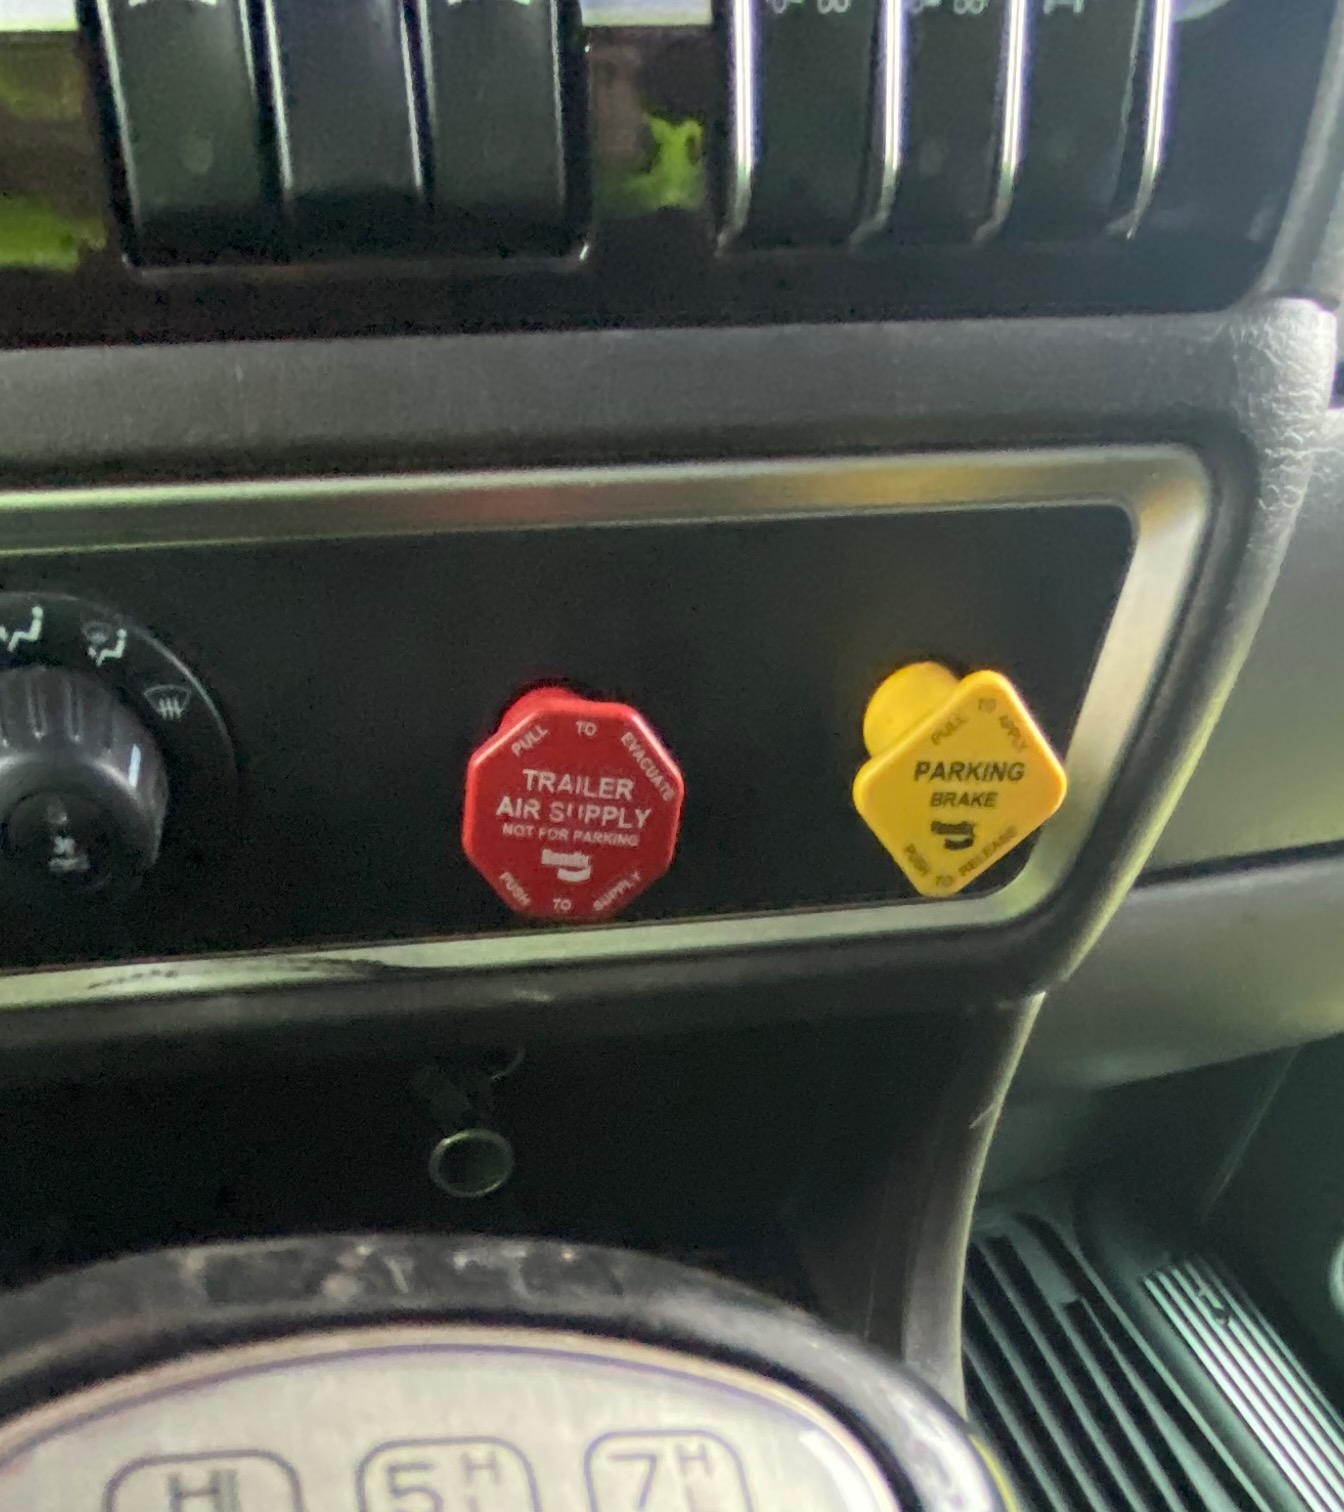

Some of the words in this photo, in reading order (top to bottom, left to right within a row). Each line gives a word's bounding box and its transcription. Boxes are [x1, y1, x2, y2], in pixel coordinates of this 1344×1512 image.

[511, 726, 549, 757] PULL
[576, 721, 597, 737] TO
[620, 731, 676, 802] EVACUATE
[913, 761, 1025, 782] PARKING
[523, 769, 634, 800] TRAILER
[930, 792, 999, 808] BRAKE
[496, 796, 540, 820] AIR
[549, 801, 653, 829] SUPPLY
[503, 823, 533, 838] NOT
[539, 827, 568, 841] FOR
[573, 830, 640, 847] PARKING
[499, 871, 531, 907] PUSH
[553, 898, 572, 912] TO
[592, 871, 641, 912] SUPPLY
[460, 1450, 501, 1488] H
[675, 1443, 714, 1477] H
